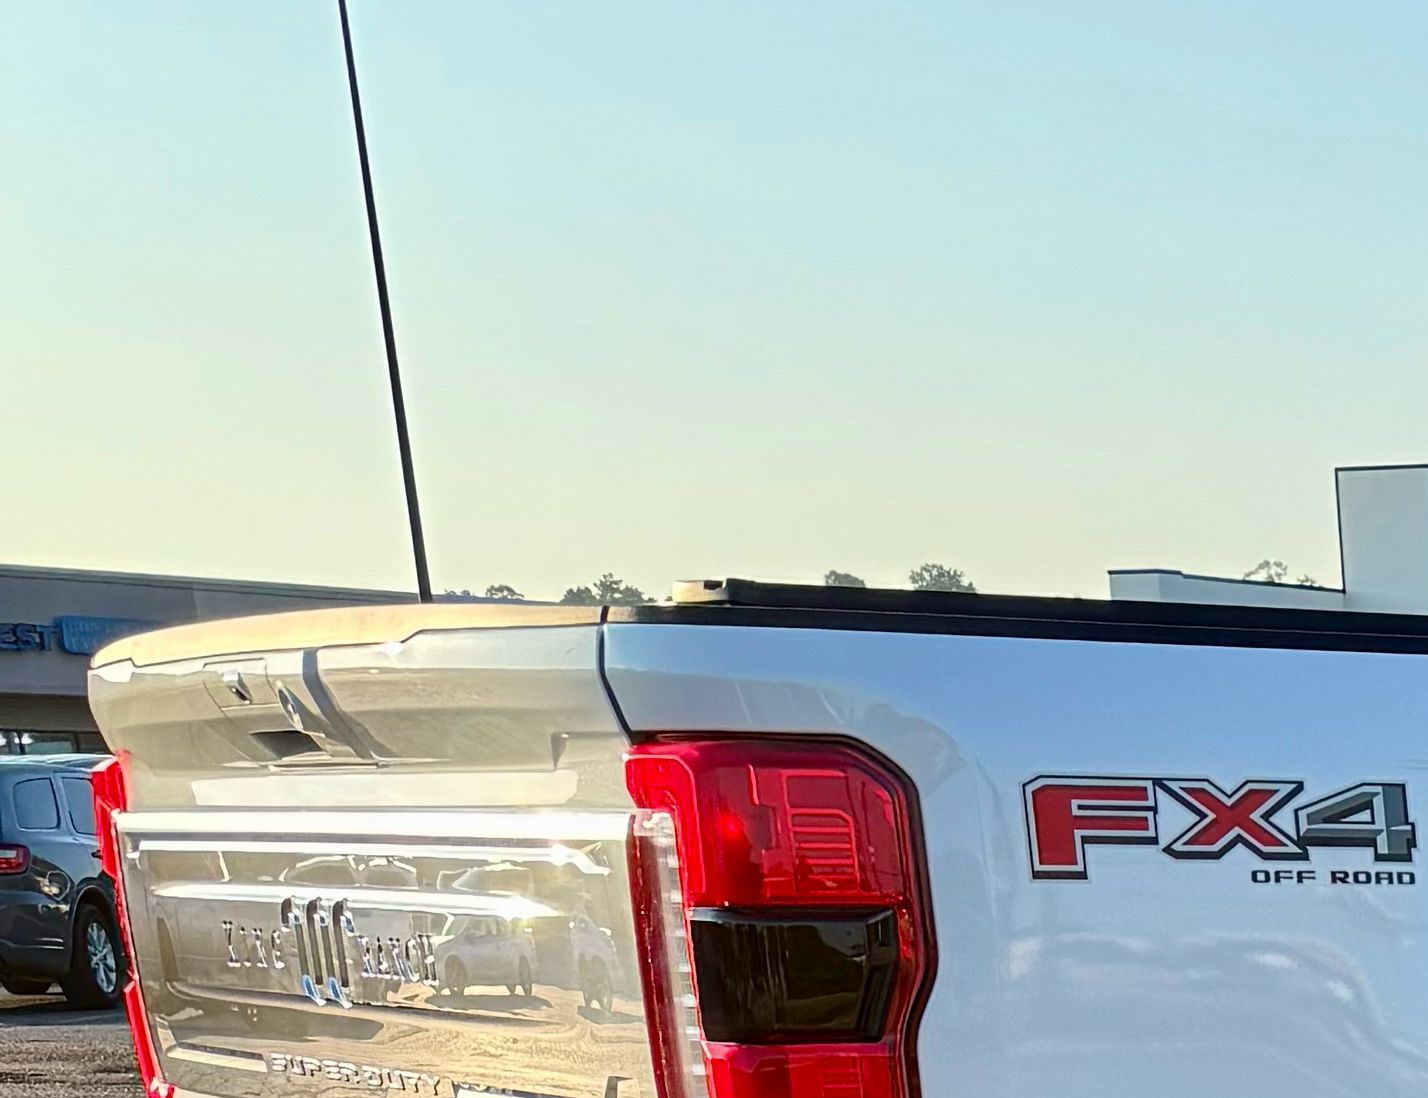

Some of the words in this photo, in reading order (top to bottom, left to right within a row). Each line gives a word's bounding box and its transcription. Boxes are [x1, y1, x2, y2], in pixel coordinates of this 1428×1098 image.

[1022, 774, 1417, 881] FX4
[1251, 869, 1317, 884] OFF
[1330, 870, 1416, 885] ROAD
